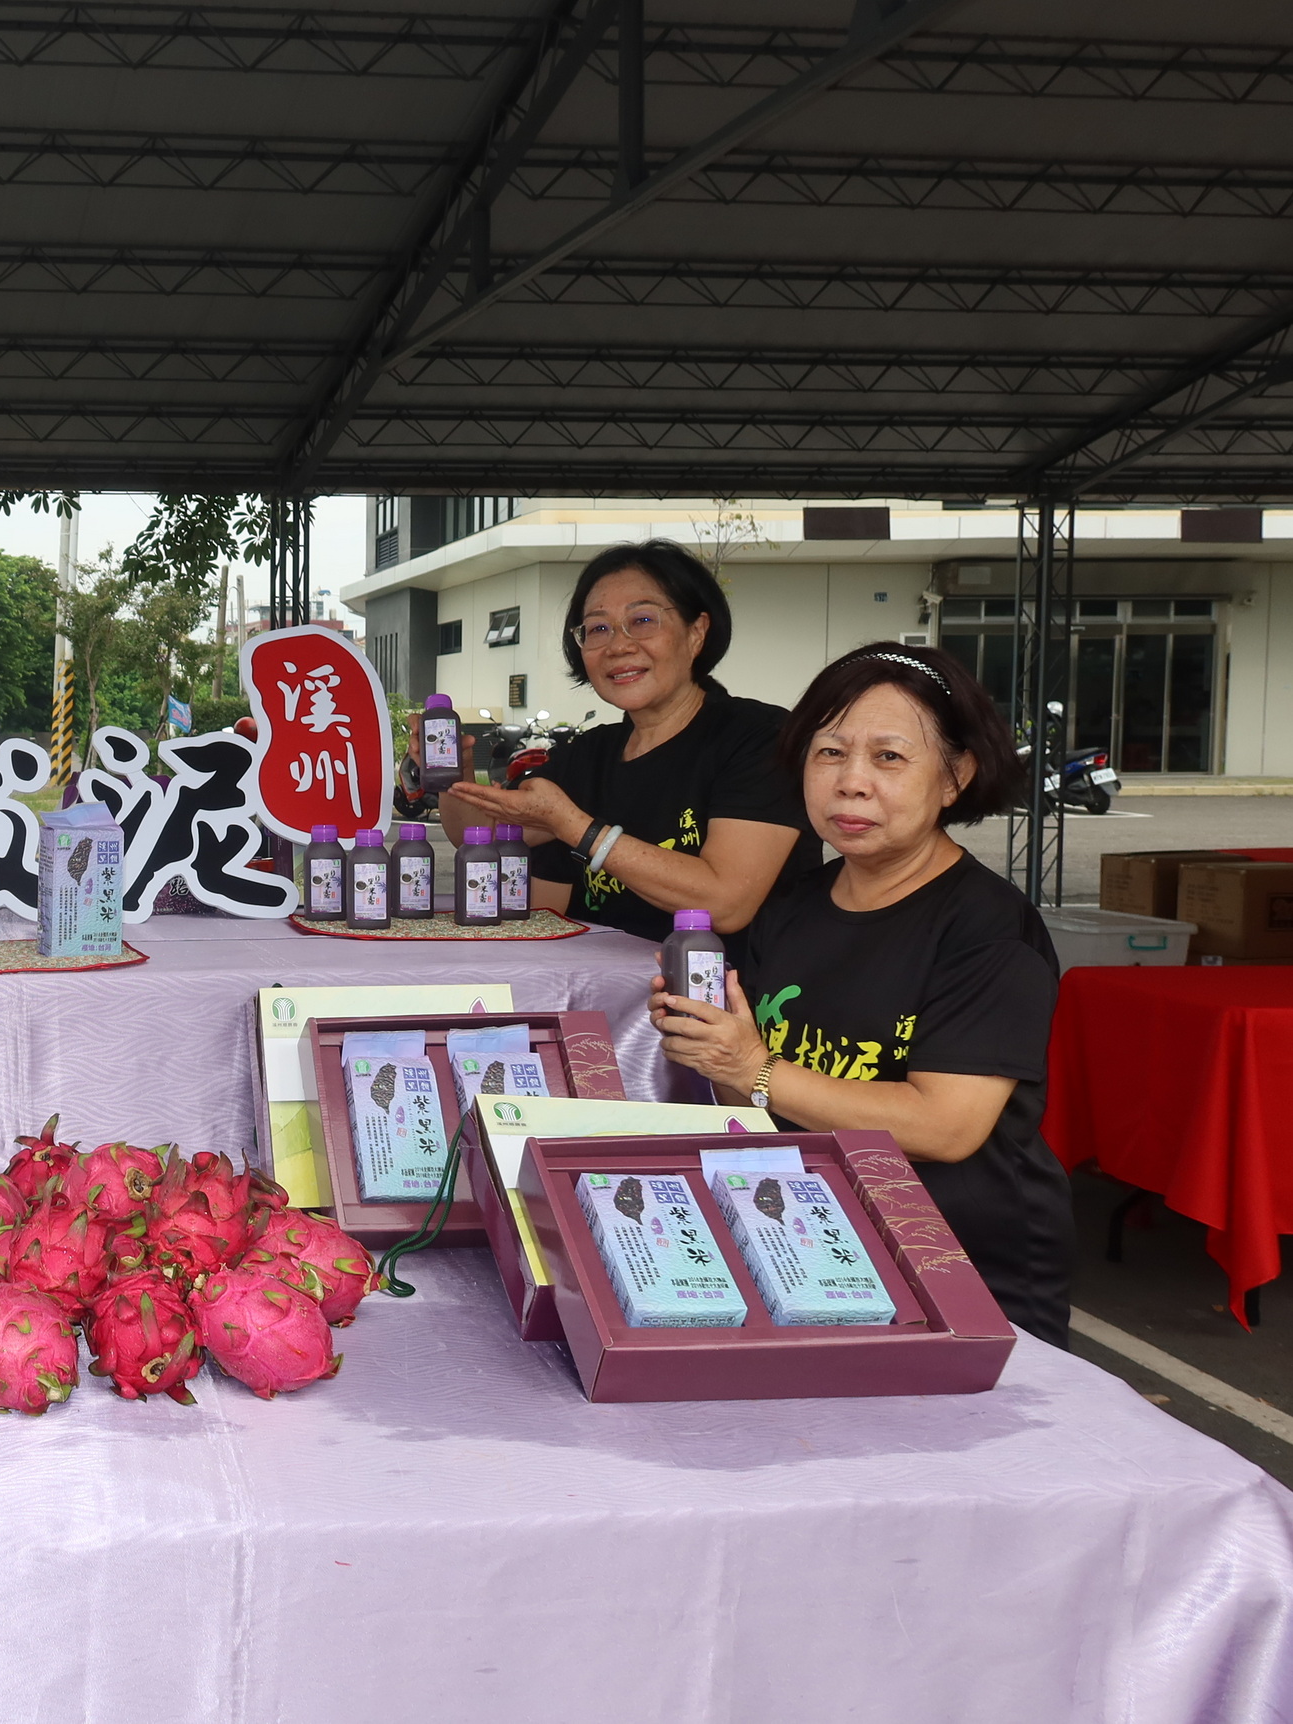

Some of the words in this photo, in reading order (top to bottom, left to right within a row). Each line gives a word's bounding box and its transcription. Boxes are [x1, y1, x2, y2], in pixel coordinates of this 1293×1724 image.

[277, 661, 362, 818] 溪州
[679, 808, 700, 847] 溪州
[100, 867, 116, 923] 紫黑米
[413, 1094, 437, 1156] 紫黑米
[669, 1206, 710, 1267] 紫黑米
[810, 1206, 857, 1267] 紫黑米
